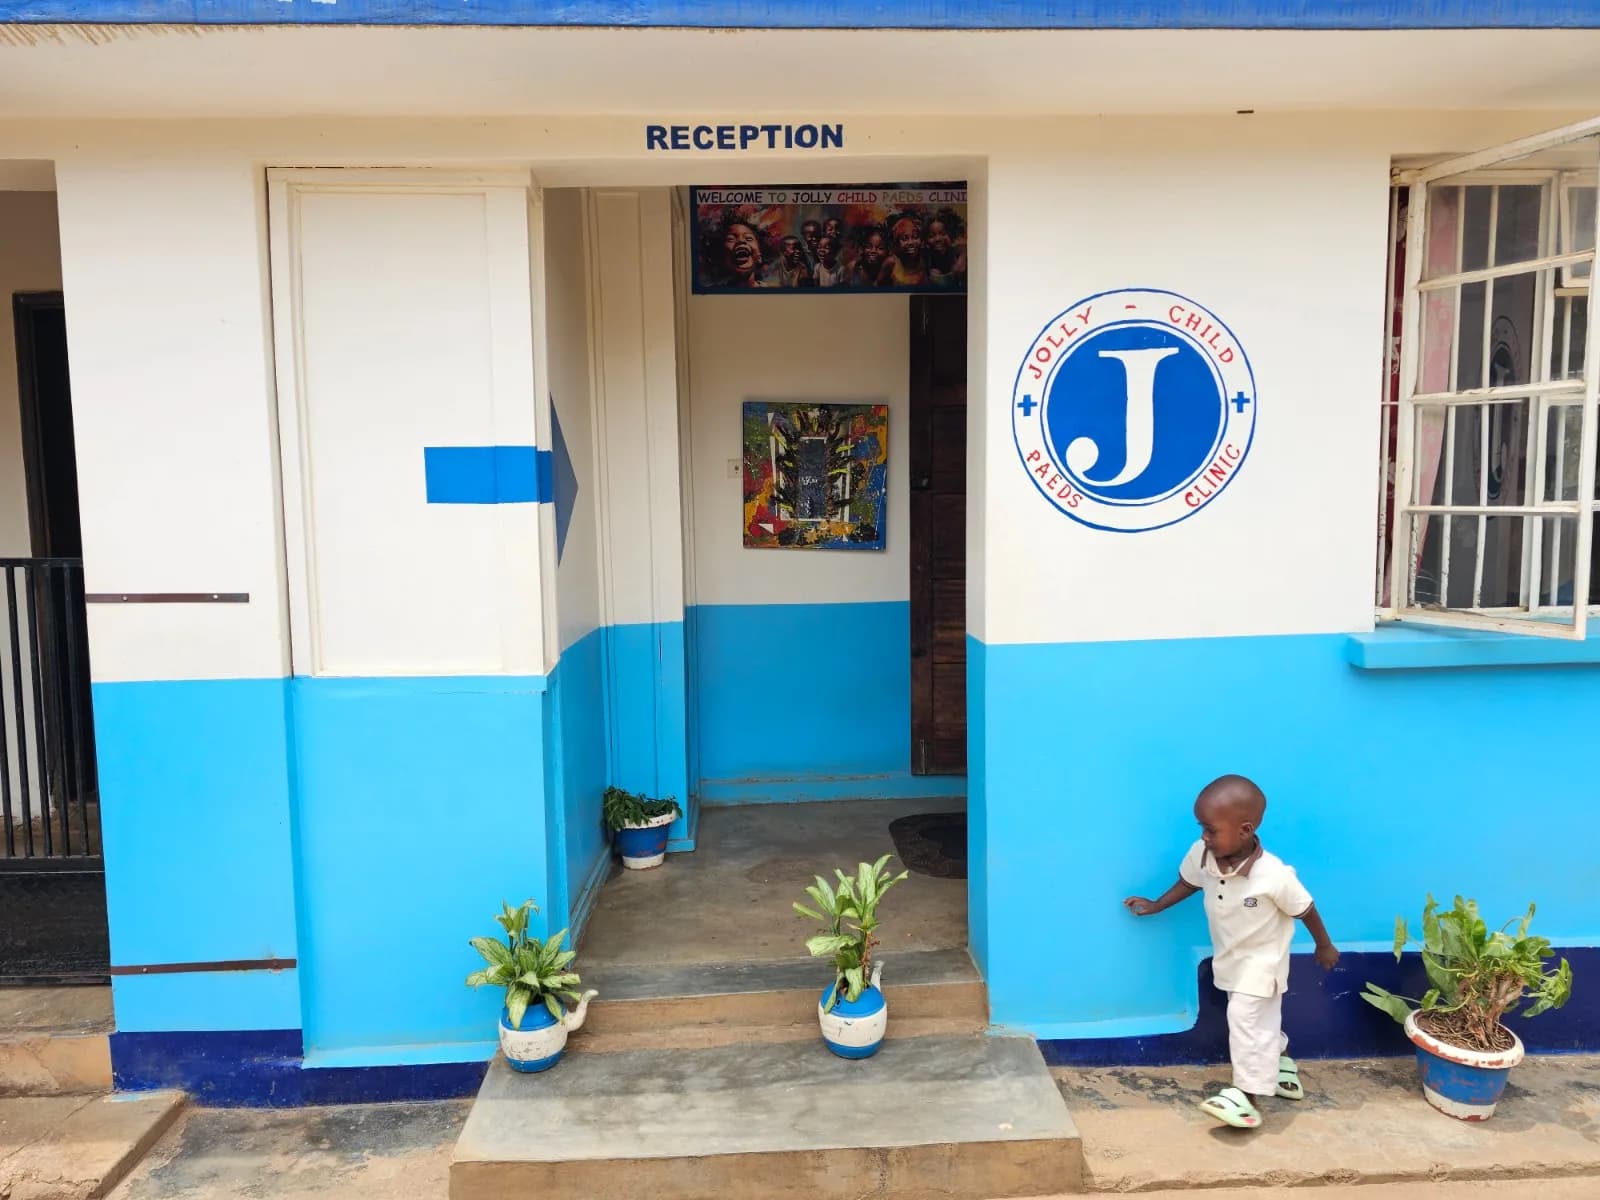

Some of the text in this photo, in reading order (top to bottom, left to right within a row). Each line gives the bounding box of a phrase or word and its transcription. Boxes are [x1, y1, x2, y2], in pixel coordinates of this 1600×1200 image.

[646, 124, 843, 150] RECEPTION
[698, 191, 967, 203] WELCOME TO JOLLY CHILD PAEDS CLINI
[1028, 306, 1092, 379] JOLLY
[1168, 305, 1234, 363] CHILD
[1066, 347, 1179, 487] J
[1026, 444, 1240, 508] PAEDS CLINIC
